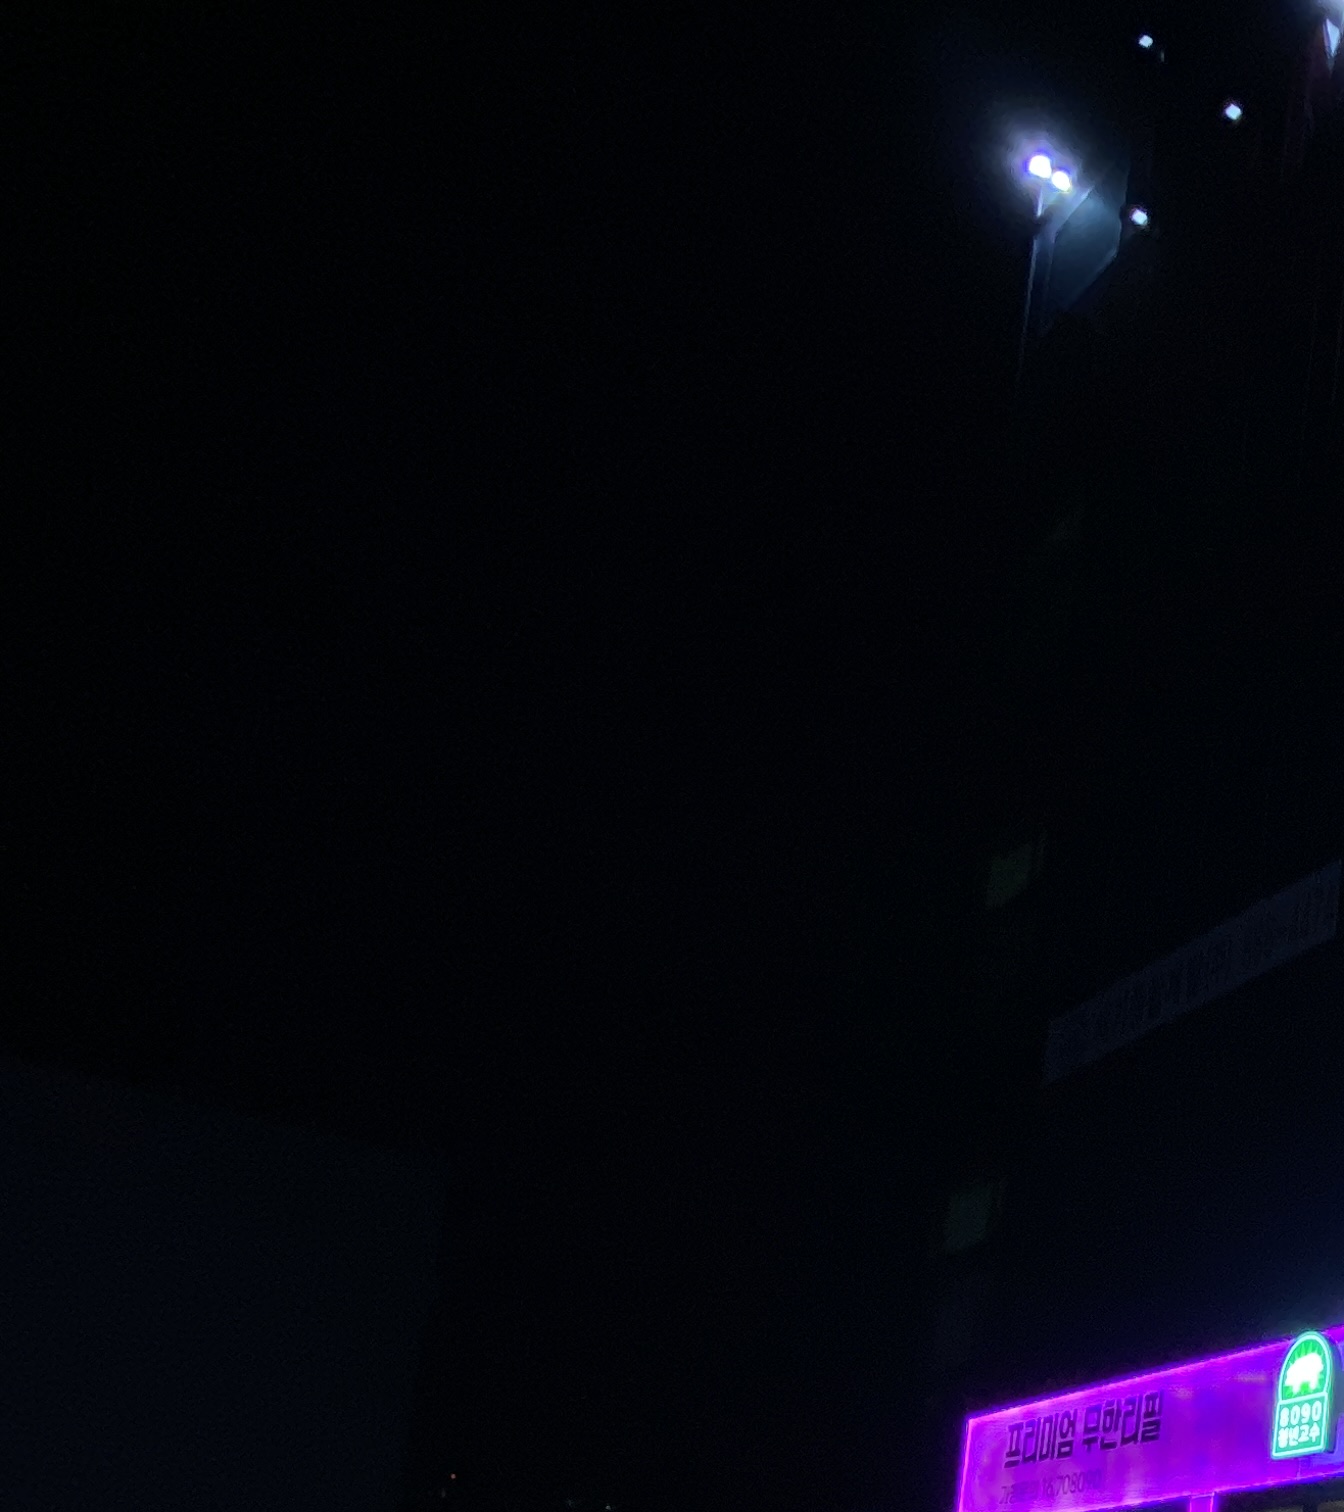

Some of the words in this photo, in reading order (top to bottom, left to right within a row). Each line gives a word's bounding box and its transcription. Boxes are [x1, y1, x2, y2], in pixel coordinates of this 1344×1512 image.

[1003, 1408, 1079, 1469] 프리미엄
[1082, 1389, 1164, 1453] 무한리필
[1279, 1400, 1323, 1427] 8090
